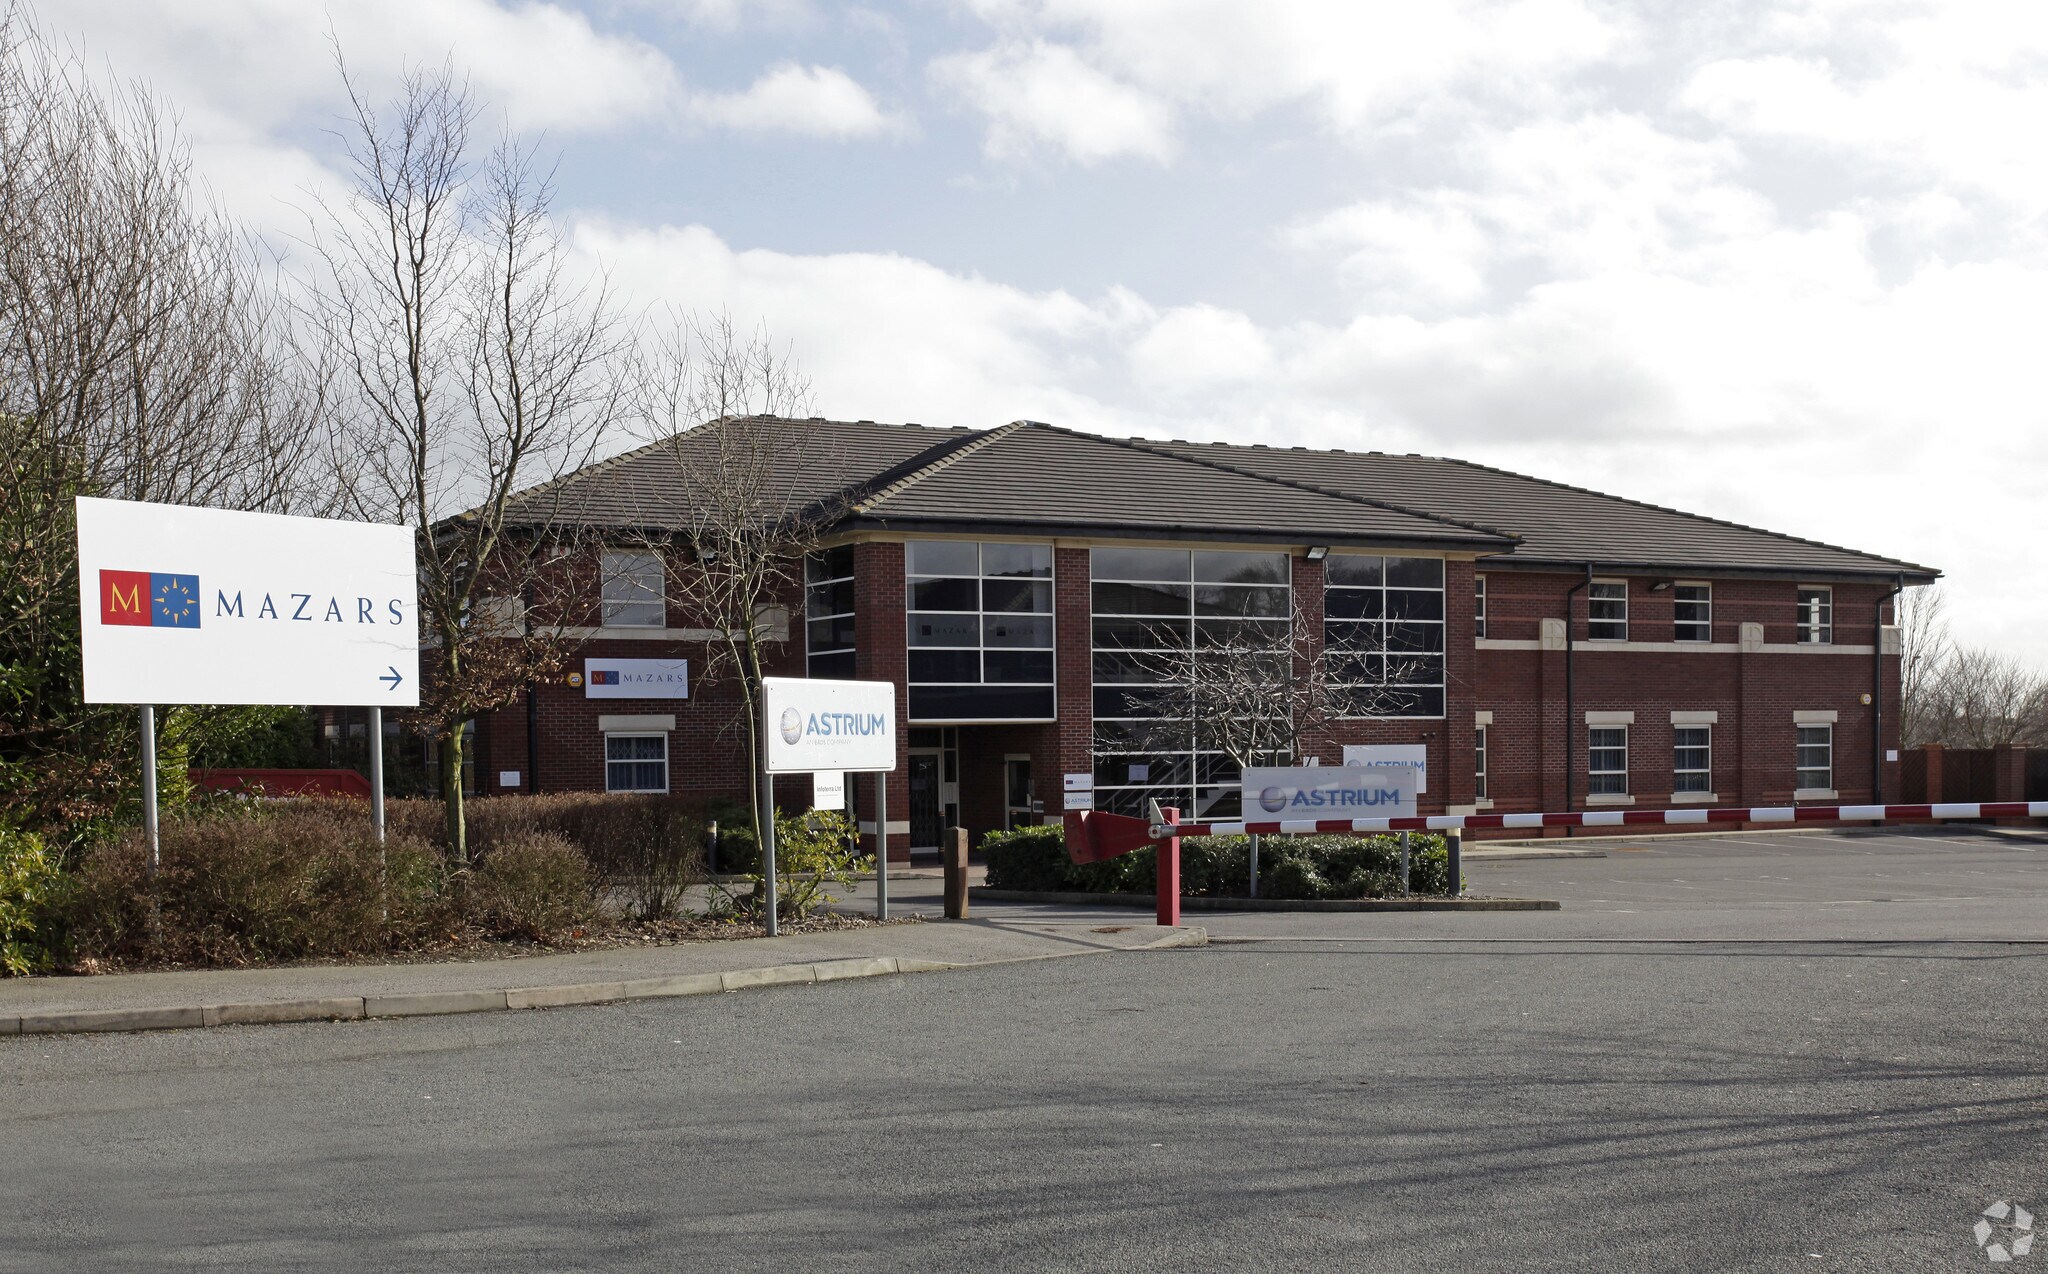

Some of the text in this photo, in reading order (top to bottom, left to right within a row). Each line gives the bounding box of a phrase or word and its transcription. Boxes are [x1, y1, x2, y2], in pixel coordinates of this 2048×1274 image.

[109, 582, 404, 626] M MAZARS
[934, 626, 969, 635] MAZAR
[593, 674, 683, 683] M MAZARS
[806, 712, 886, 736] ASTRIUM
[827, 738, 852, 746] COMPANY
[1291, 789, 1400, 807] ASTRIUM
